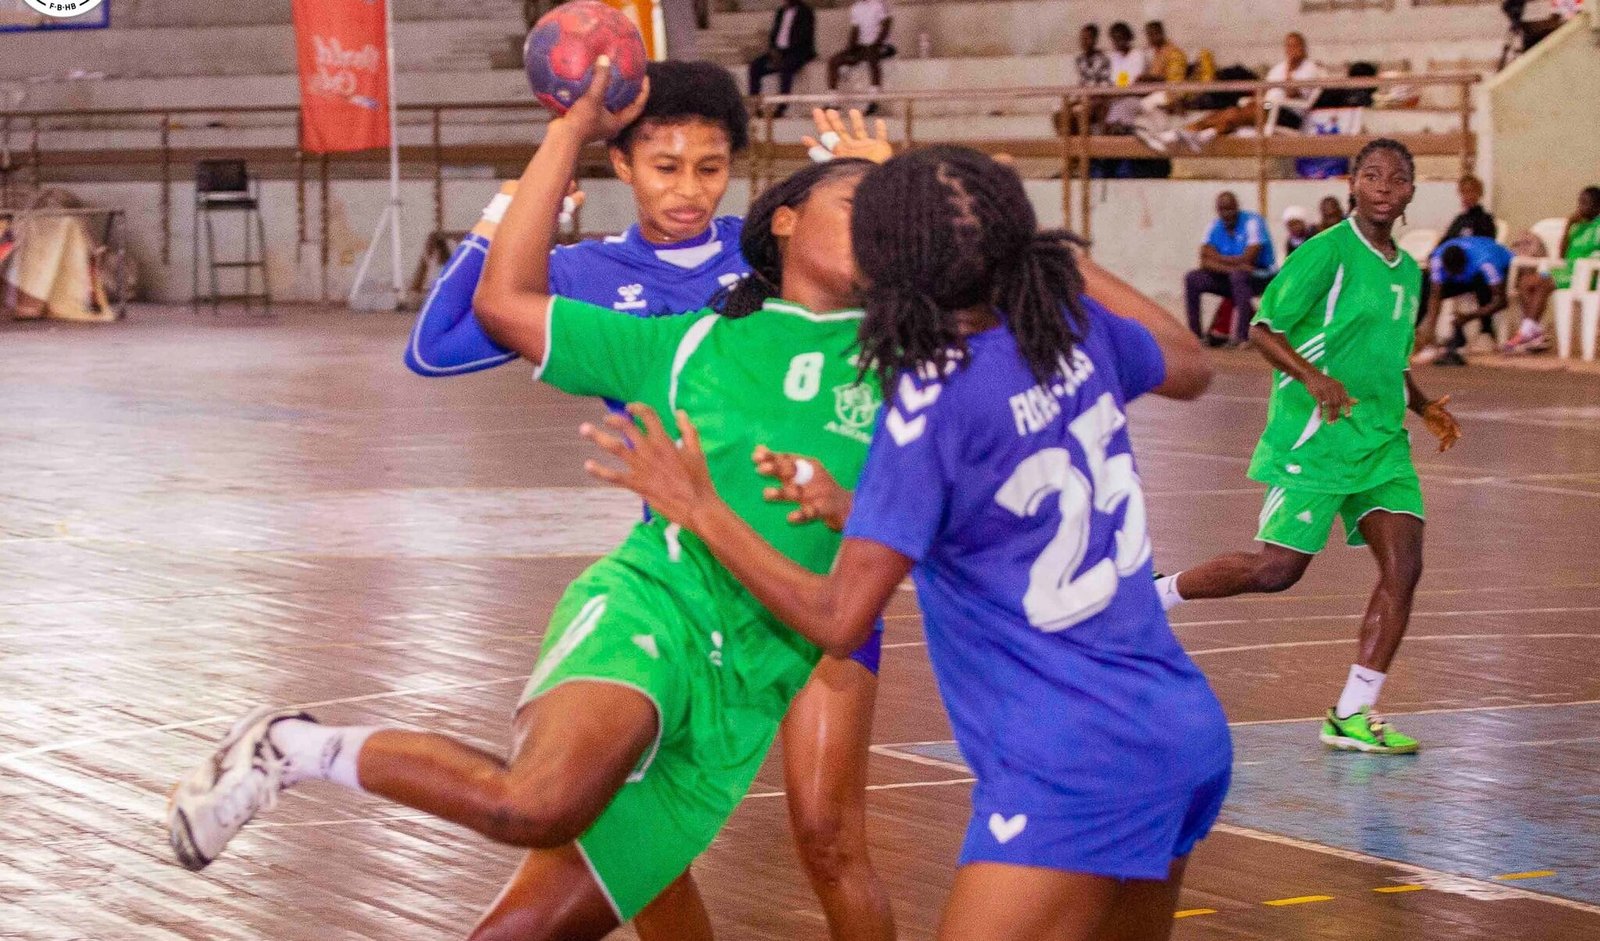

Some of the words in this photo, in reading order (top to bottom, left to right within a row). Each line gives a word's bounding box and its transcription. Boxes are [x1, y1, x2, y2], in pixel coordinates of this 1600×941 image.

[1391, 284, 1404, 320] 7
[783, 352, 825, 401] 8
[995, 392, 1151, 632] 25
